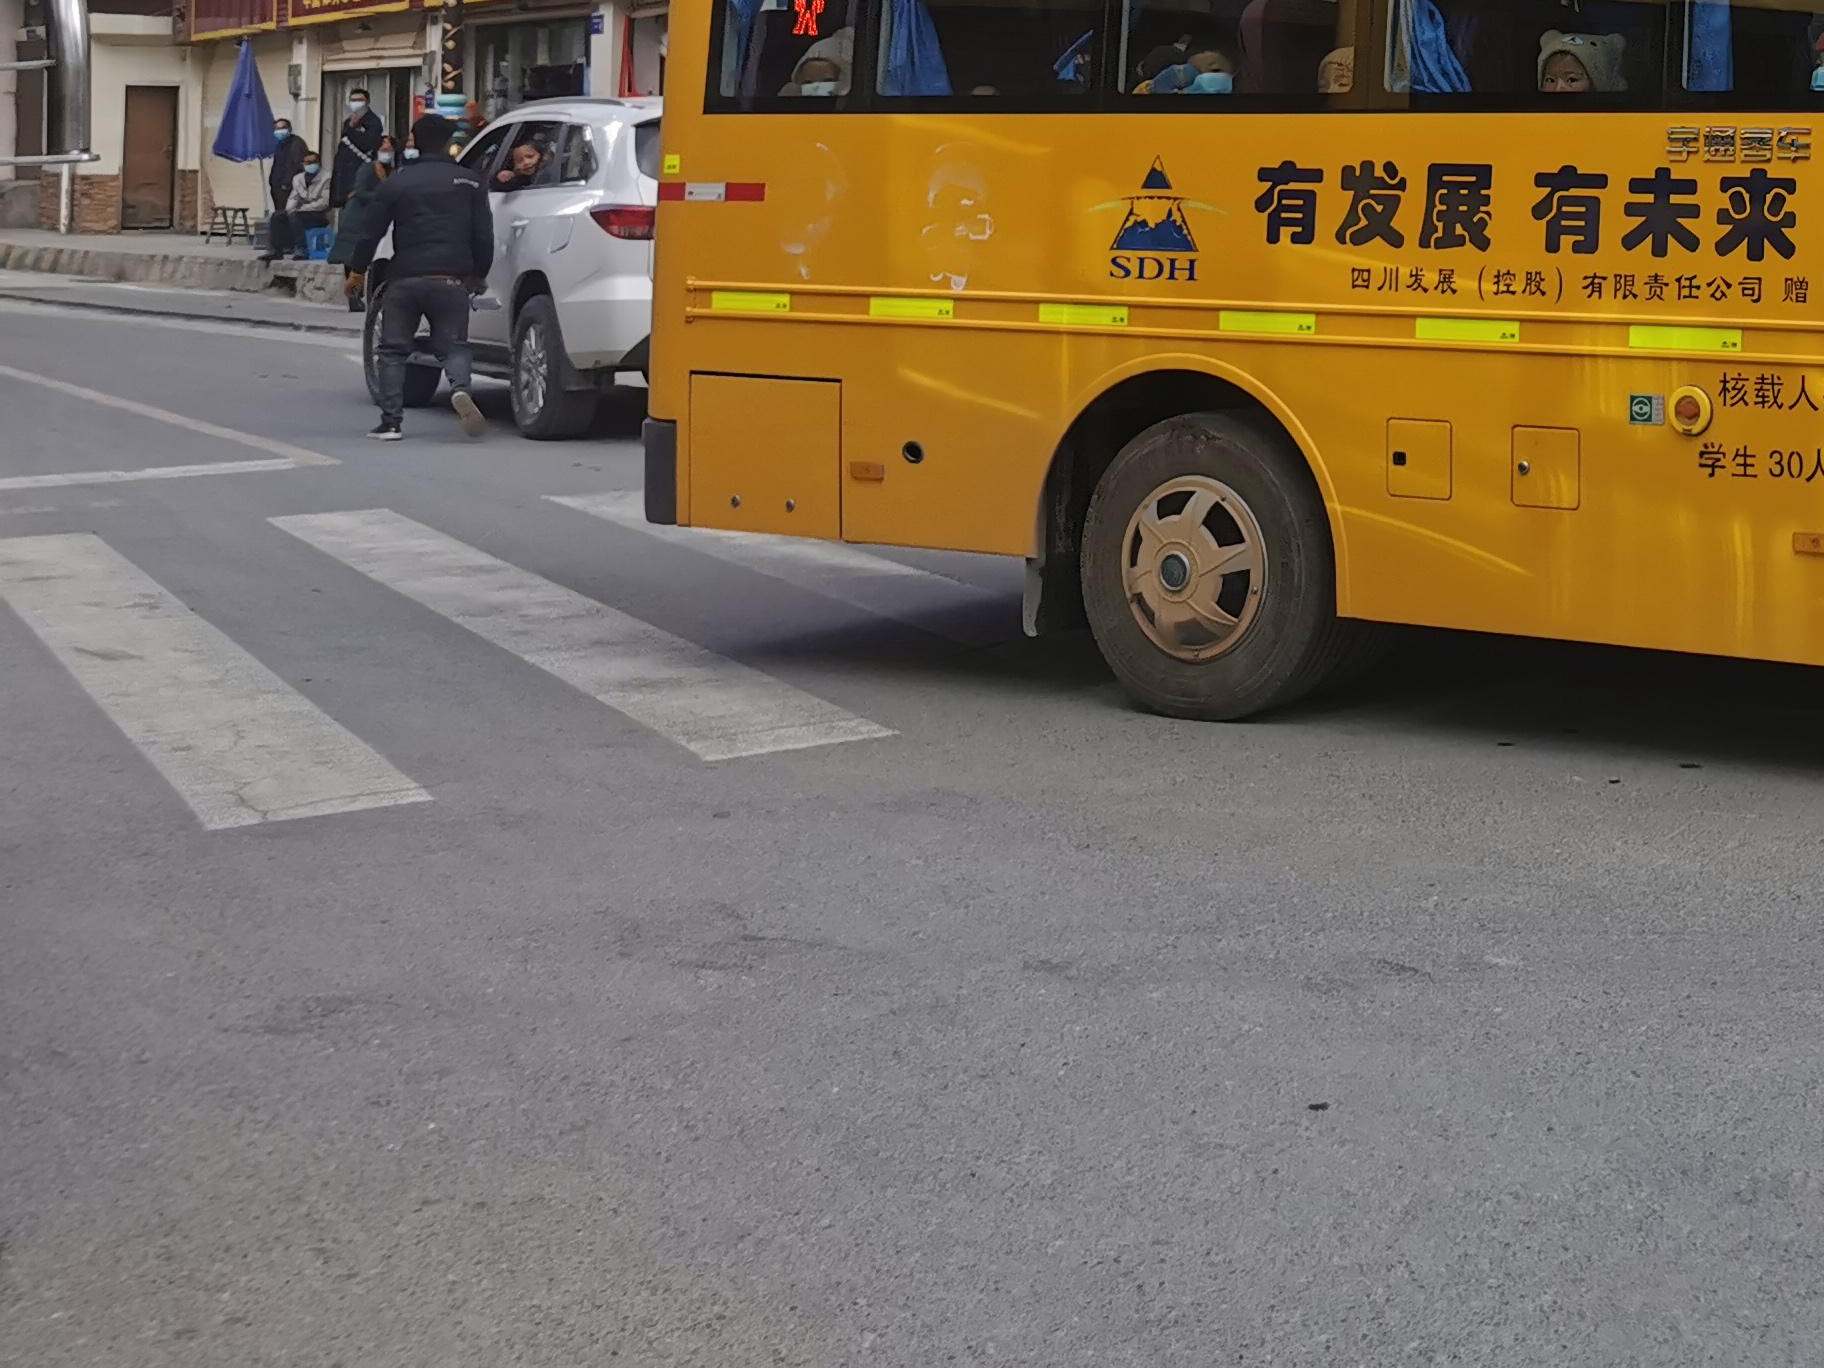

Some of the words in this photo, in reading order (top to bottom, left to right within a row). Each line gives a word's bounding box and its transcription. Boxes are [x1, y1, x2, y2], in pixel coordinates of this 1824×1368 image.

[1666, 125, 1812, 164] 宇通客车
[1254, 159, 1494, 252] 有发展
[1531, 165, 1798, 263] 有未来
[1109, 254, 1198, 282] SDH
